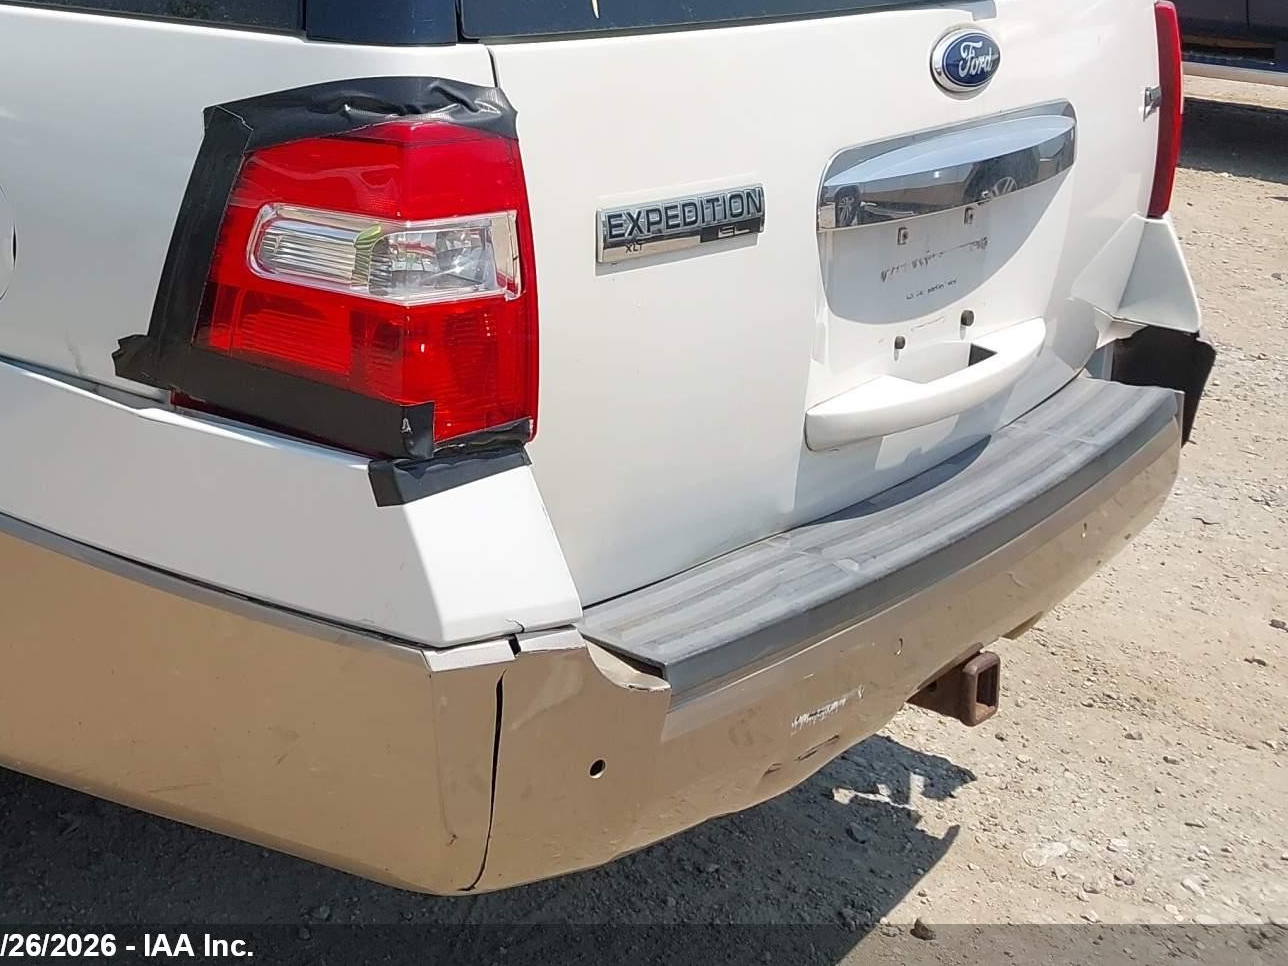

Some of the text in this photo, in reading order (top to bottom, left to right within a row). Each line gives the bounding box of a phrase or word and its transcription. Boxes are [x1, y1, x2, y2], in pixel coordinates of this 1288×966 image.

[958, 40, 999, 78] Ford
[606, 186, 763, 240] EXPEDITION
[718, 224, 751, 238] EL
[624, 242, 644, 254] XLT
